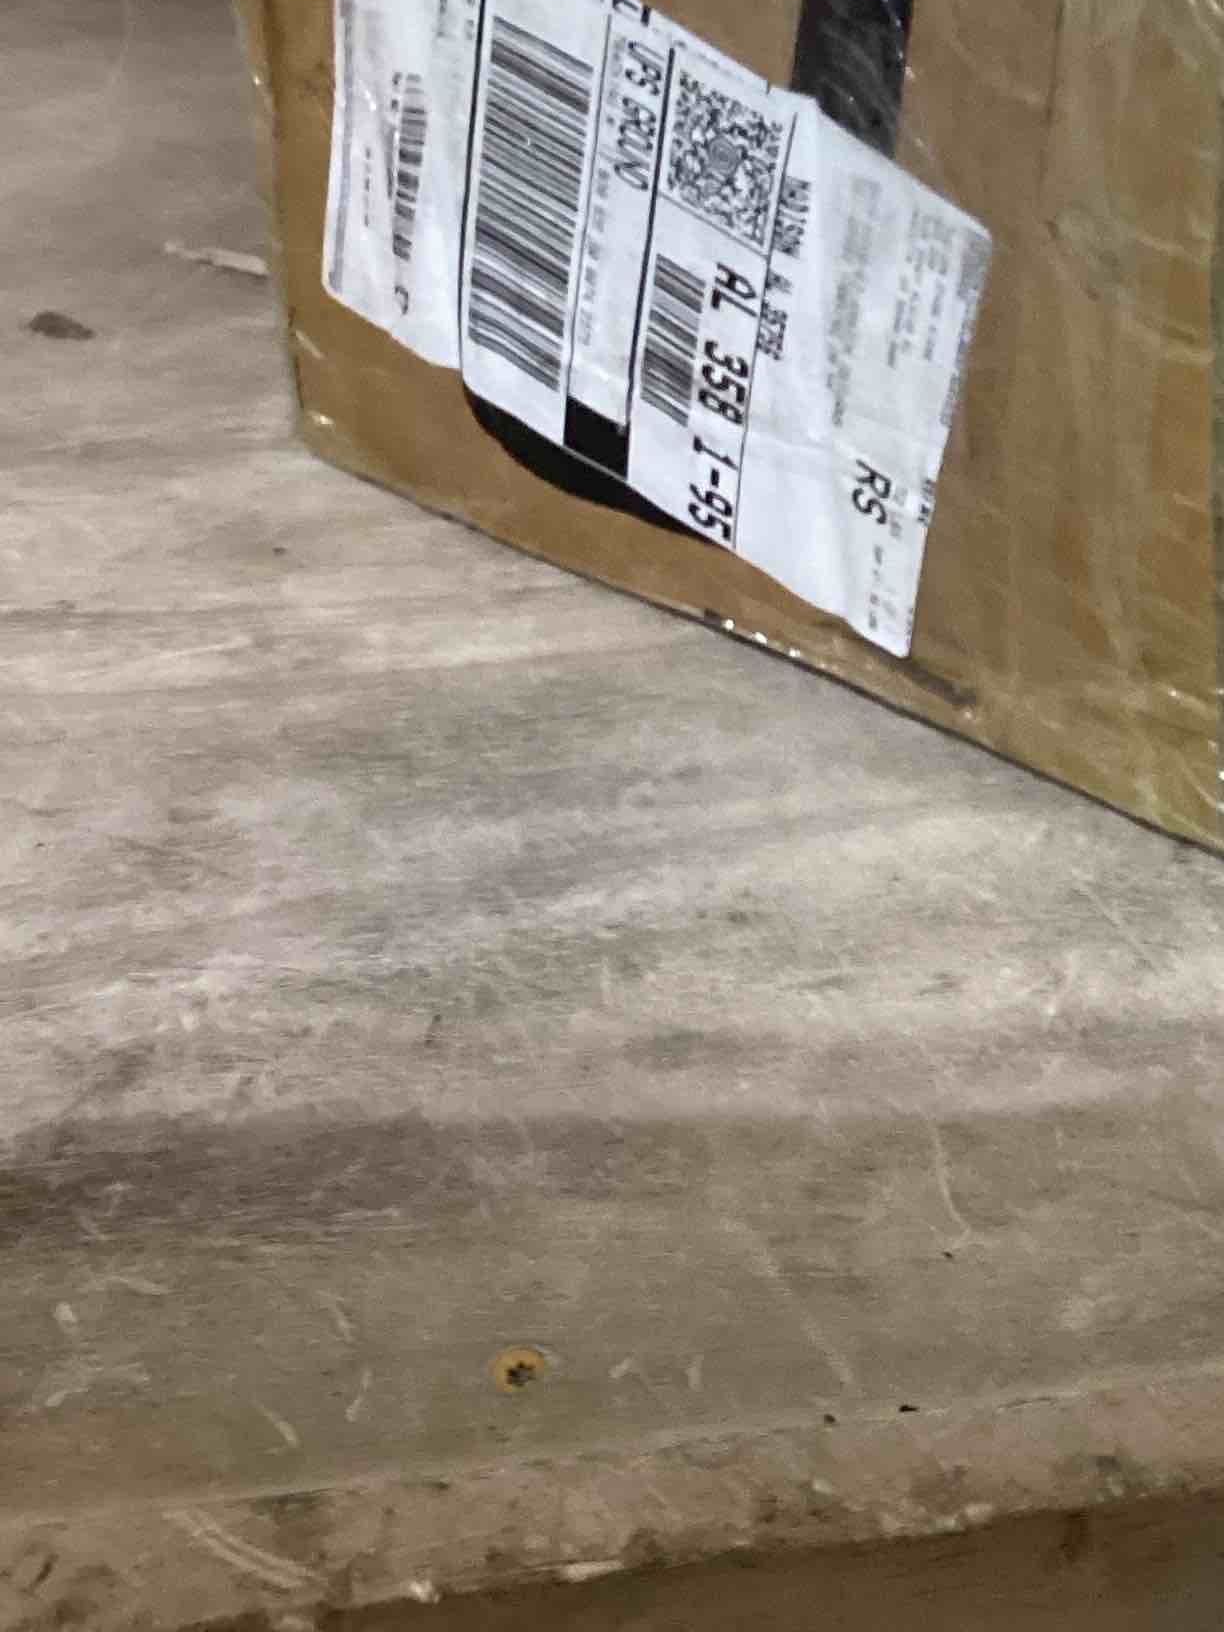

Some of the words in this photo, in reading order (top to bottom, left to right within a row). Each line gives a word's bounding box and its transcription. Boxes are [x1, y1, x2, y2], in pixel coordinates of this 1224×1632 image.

[623, 40, 665, 97] UPS
[612, 97, 658, 193] GROUND
[709, 261, 758, 318] AL
[696, 339, 748, 425] 358
[686, 435, 738, 542] 1-95
[850, 459, 891, 525] RS
